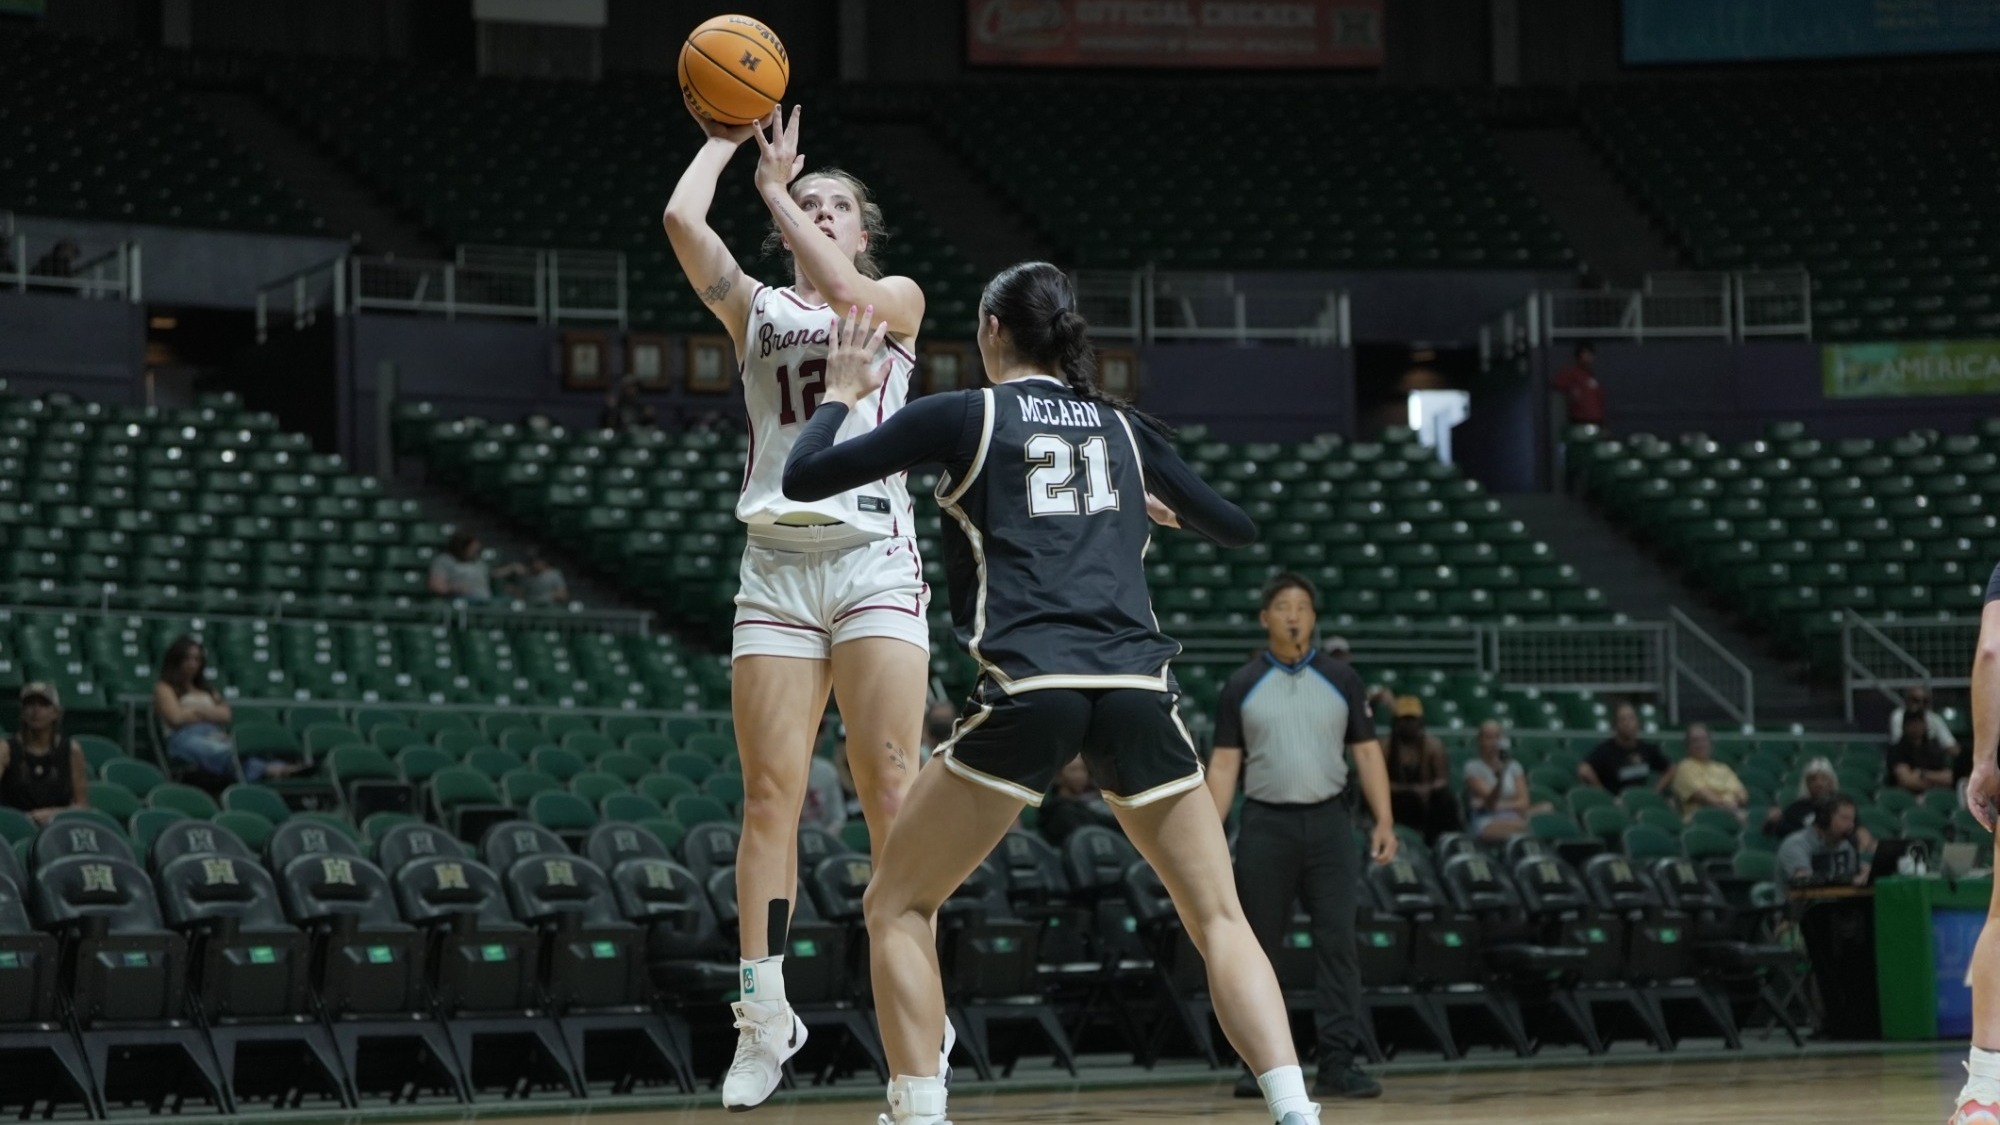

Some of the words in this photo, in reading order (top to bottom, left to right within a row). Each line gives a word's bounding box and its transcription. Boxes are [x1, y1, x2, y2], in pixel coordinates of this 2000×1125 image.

[739, 50, 762, 71] H
[758, 322, 841, 359] Bronc
[1024, 433, 1120, 518] 21
